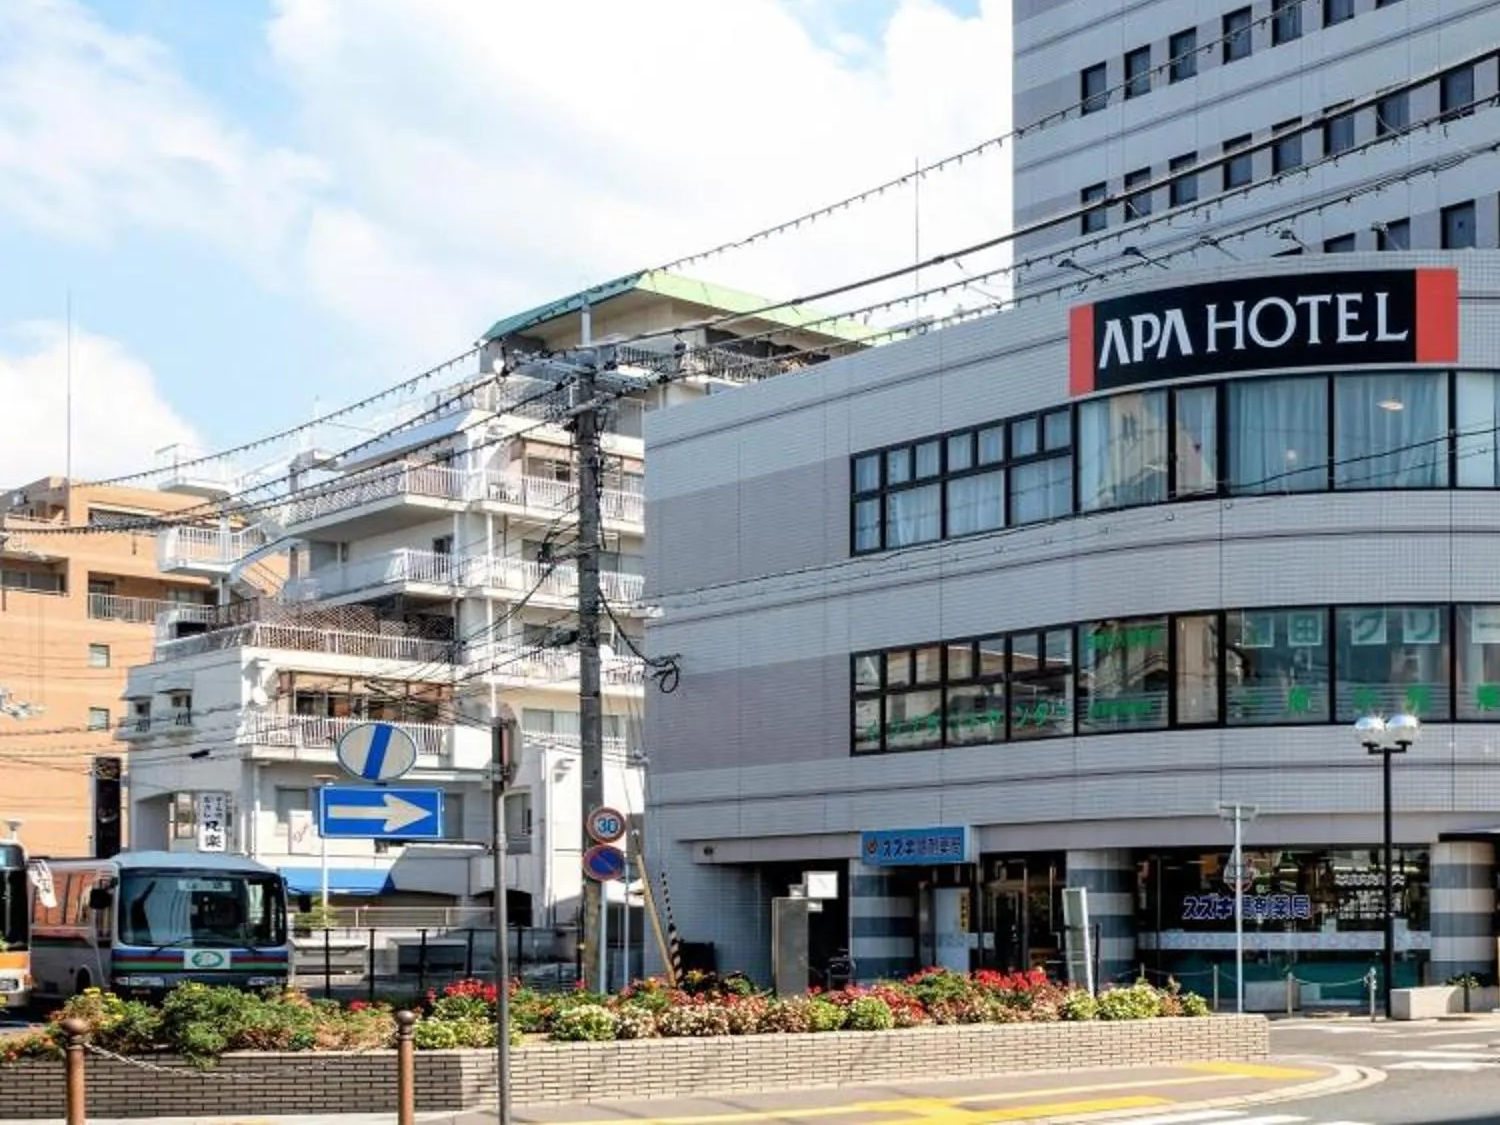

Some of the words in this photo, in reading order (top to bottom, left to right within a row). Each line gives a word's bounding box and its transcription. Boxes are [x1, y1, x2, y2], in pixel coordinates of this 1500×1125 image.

[1099, 307, 1193, 370] APA
[1205, 292, 1408, 354] HOTEL
[598, 818, 618, 833] 30
